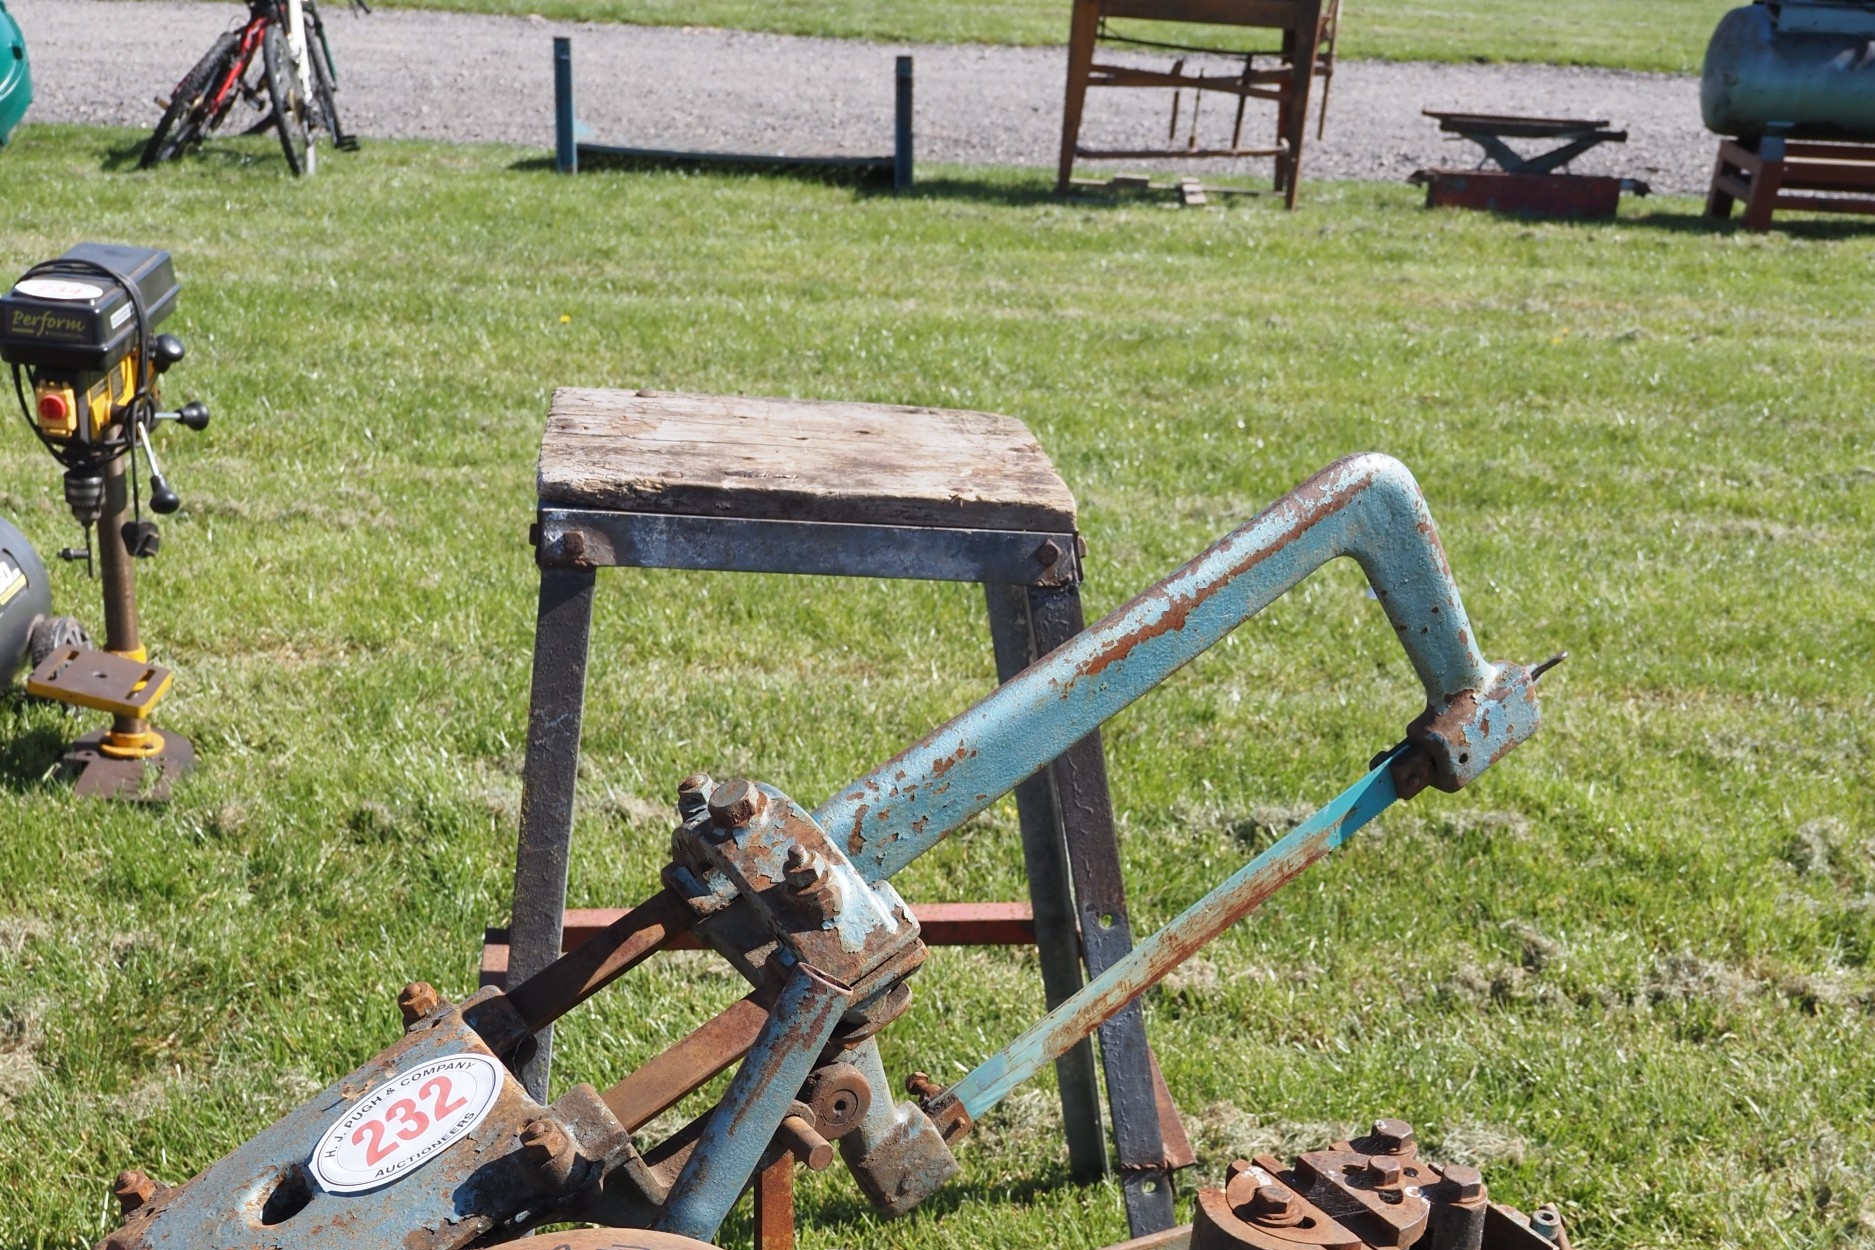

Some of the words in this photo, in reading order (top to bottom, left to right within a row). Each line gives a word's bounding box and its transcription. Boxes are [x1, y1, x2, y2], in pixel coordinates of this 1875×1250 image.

[12, 310, 86, 337] Perform
[324, 1147, 338, 1159] H.
[334, 1133, 347, 1143] J.
[344, 1096, 383, 1129] PUGH
[386, 1087, 396, 1096] &
[400, 1061, 477, 1087] COMPANY
[351, 1075, 469, 1167] 232
[375, 1112, 475, 1178] AUCTIONEERS
